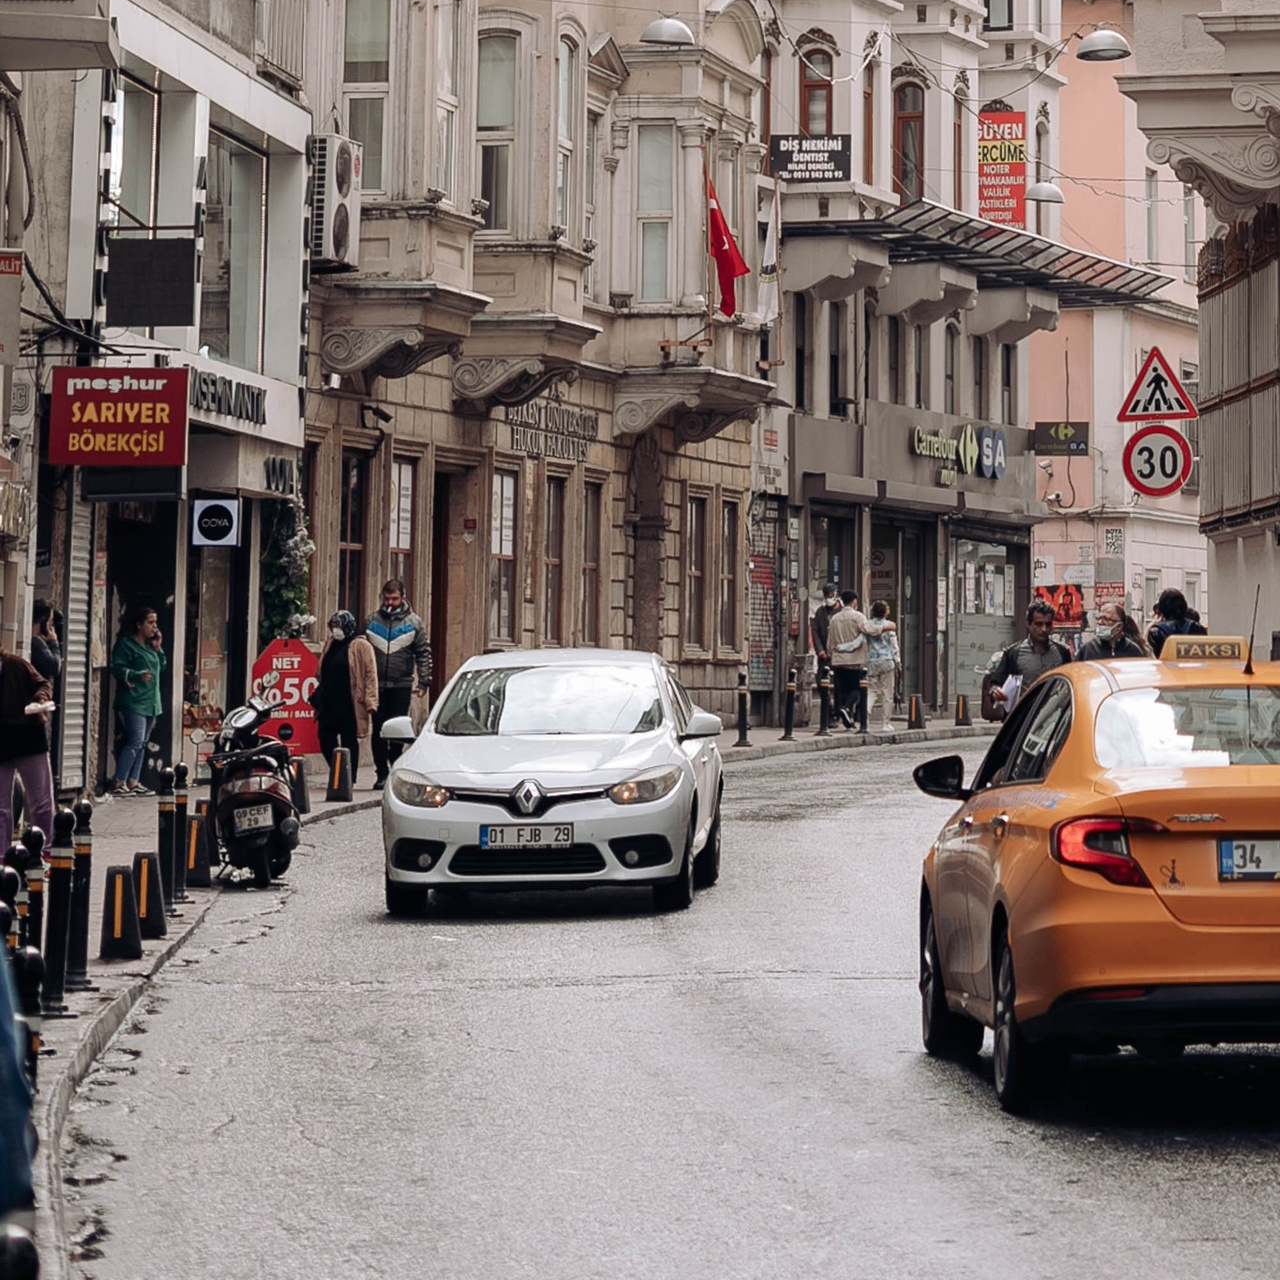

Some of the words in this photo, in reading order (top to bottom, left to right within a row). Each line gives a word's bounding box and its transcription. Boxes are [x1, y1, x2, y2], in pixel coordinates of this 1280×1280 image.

[802, 136, 842, 151] HEKİMİ
[978, 142, 1024, 162] RCÜME
[983, 165, 1010, 174] NOTER
[67, 375, 168, 395] meşhur
[72, 401, 170, 424] SARIYER
[68, 429, 164, 456] BÖREKÇİSİ
[914, 425, 957, 460] Carrefour
[982, 437, 1006, 468] SA
[1137, 446, 1178, 479] 30
[272, 657, 302, 669] NET
[489, 828, 505, 844] 01
[517, 828, 542, 844] FJB
[554, 827, 570, 843] 29
[1234, 843, 1262, 869] 34
